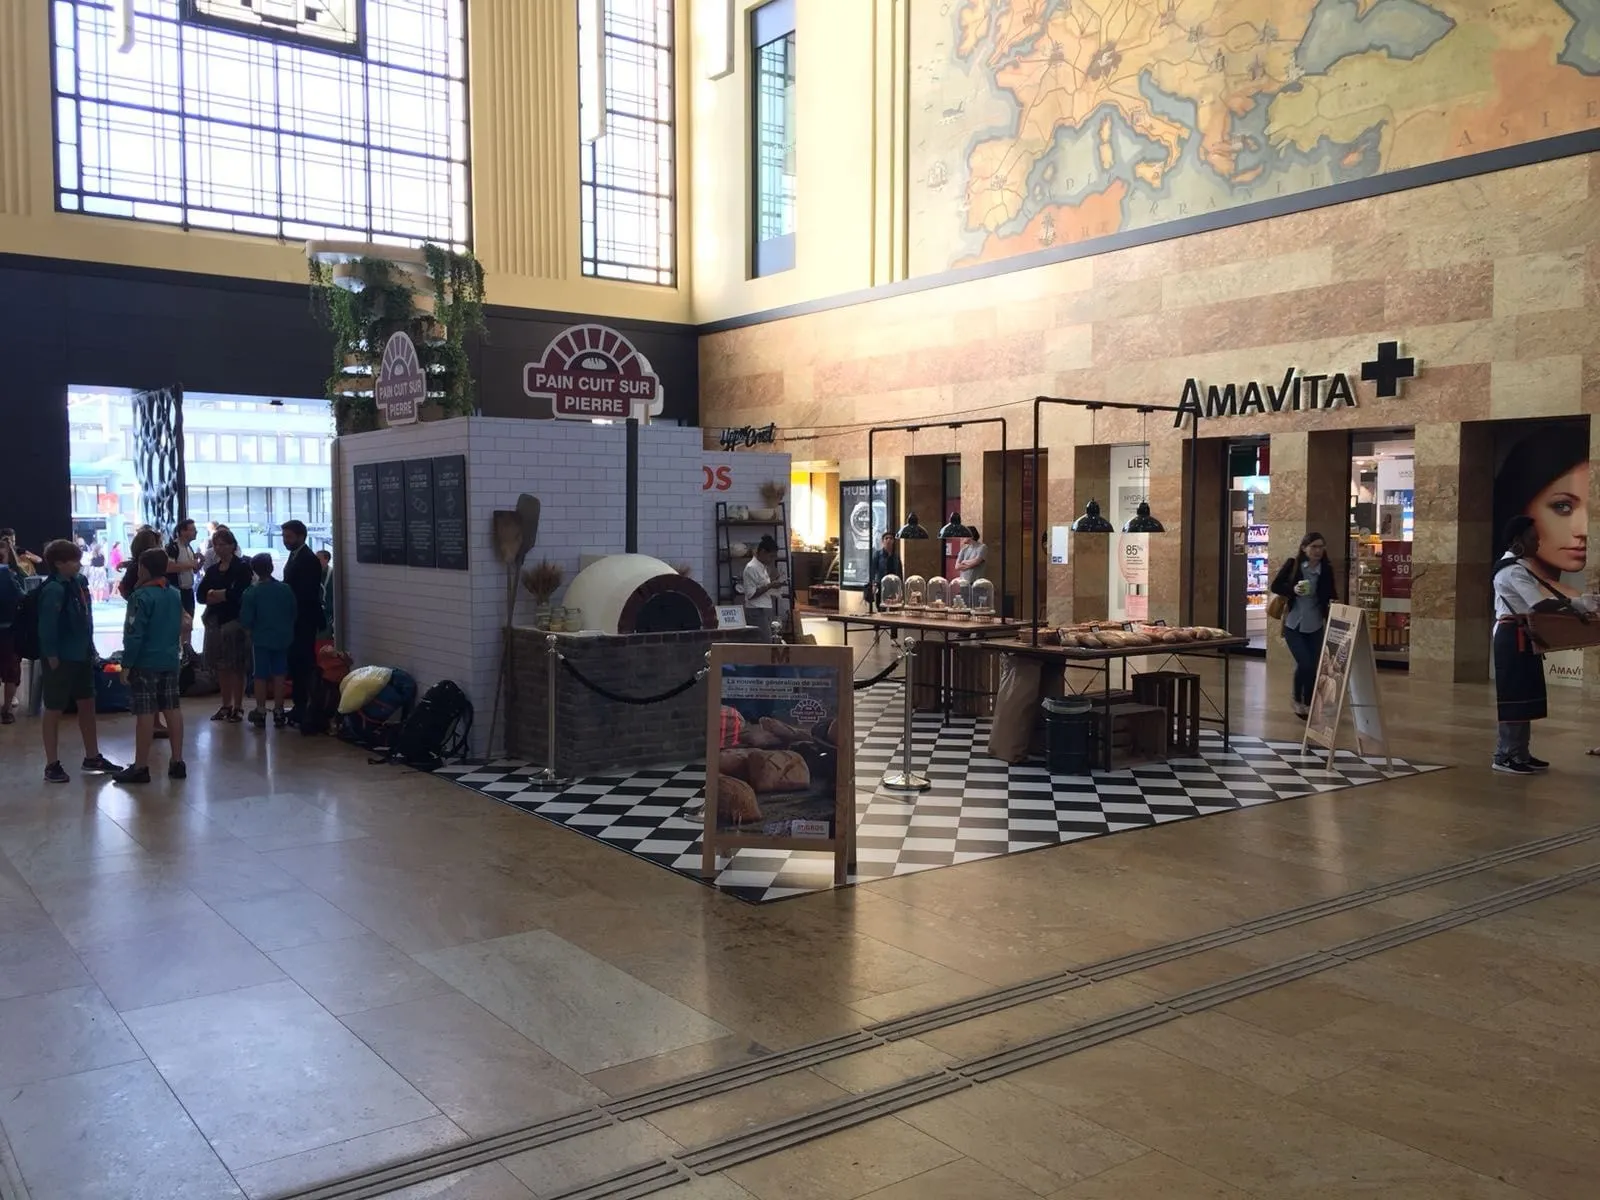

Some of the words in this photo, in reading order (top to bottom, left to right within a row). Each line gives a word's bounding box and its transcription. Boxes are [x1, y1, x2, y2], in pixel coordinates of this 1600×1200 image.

[379, 384, 393, 399] PAIN
[393, 382, 408, 396] CUIT
[409, 380, 422, 394] SUR
[536, 374, 573, 389] PAIN
[578, 377, 615, 392] CUIT
[619, 380, 650, 394] SUR
[565, 396, 623, 412] PIERRE
[1173, 367, 1355, 428] AMAVITA
[389, 401, 413, 416] PIERRE
